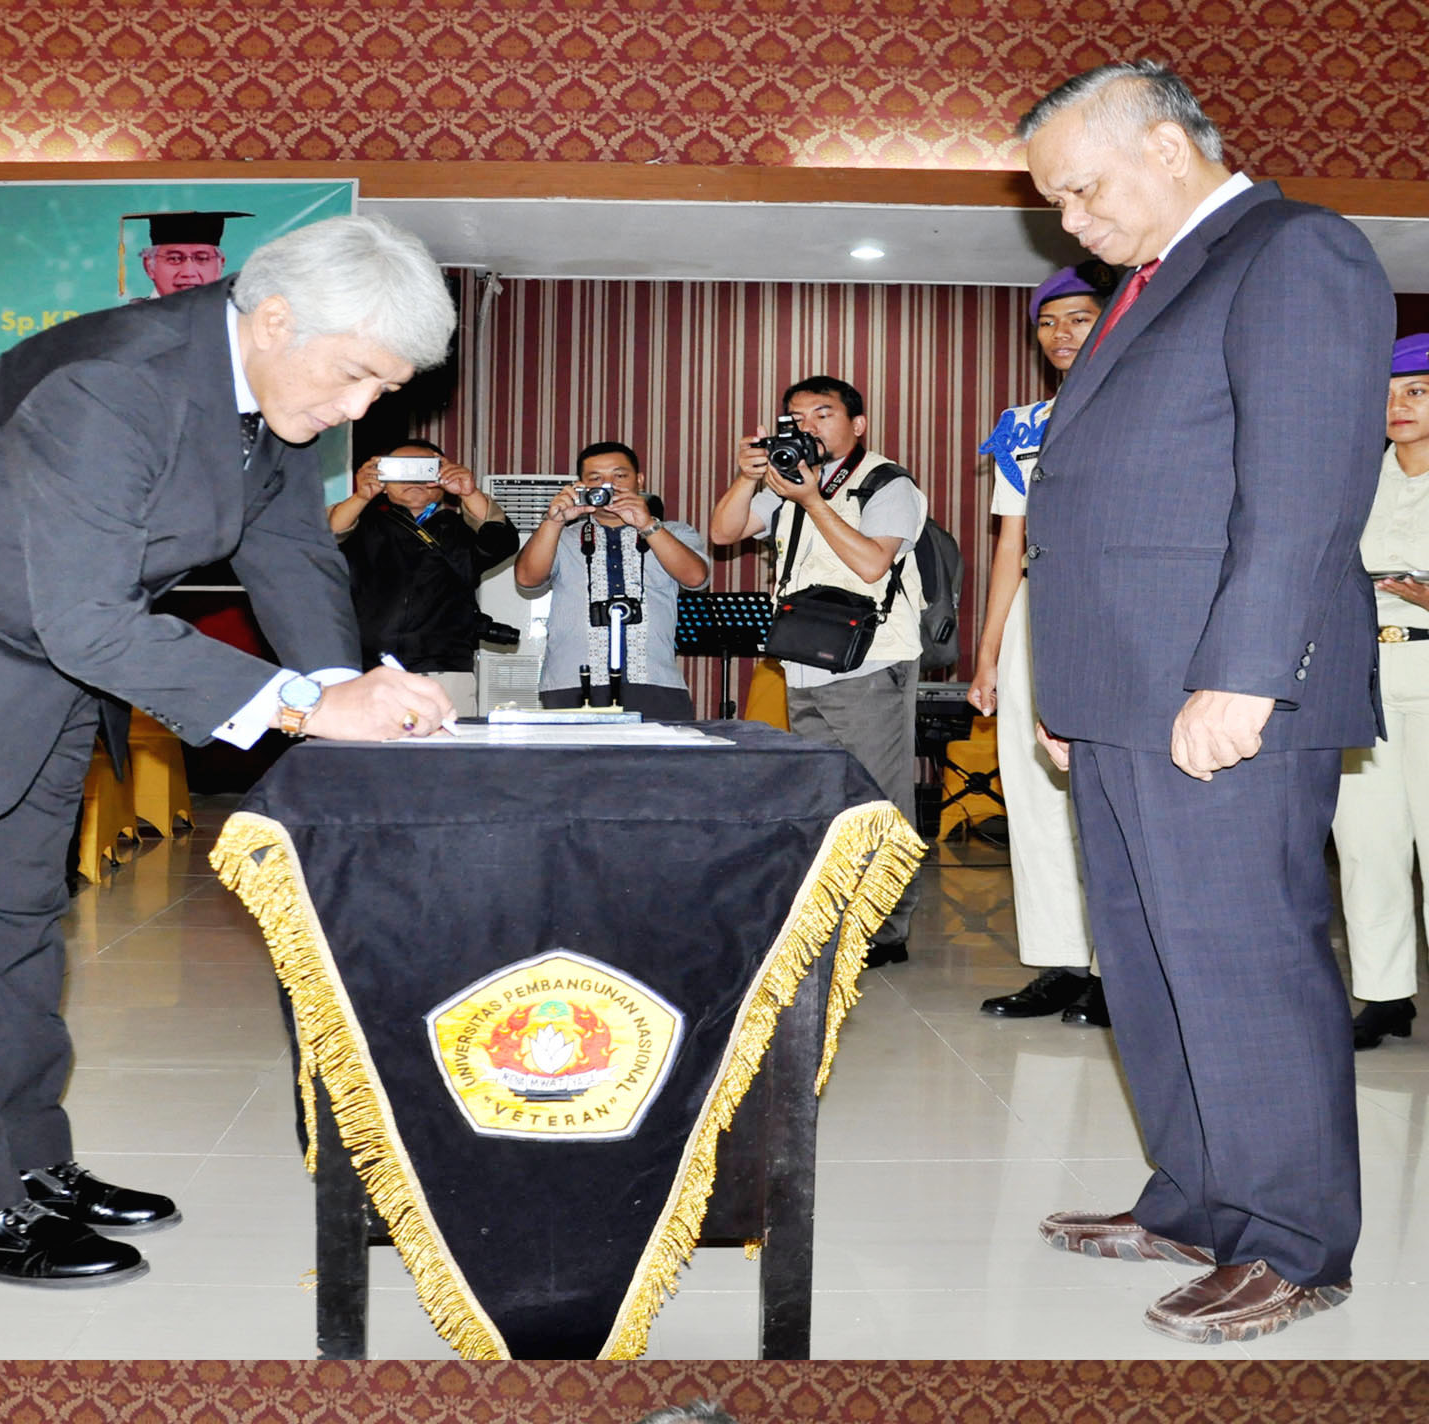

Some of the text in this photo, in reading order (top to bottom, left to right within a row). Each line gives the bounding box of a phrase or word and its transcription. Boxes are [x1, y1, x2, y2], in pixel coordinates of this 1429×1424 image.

[455, 978, 652, 1092] UNIVERSITAS PEMBANGUNAN NASIONAL
[484, 1095, 617, 1127] "VETERAN"
